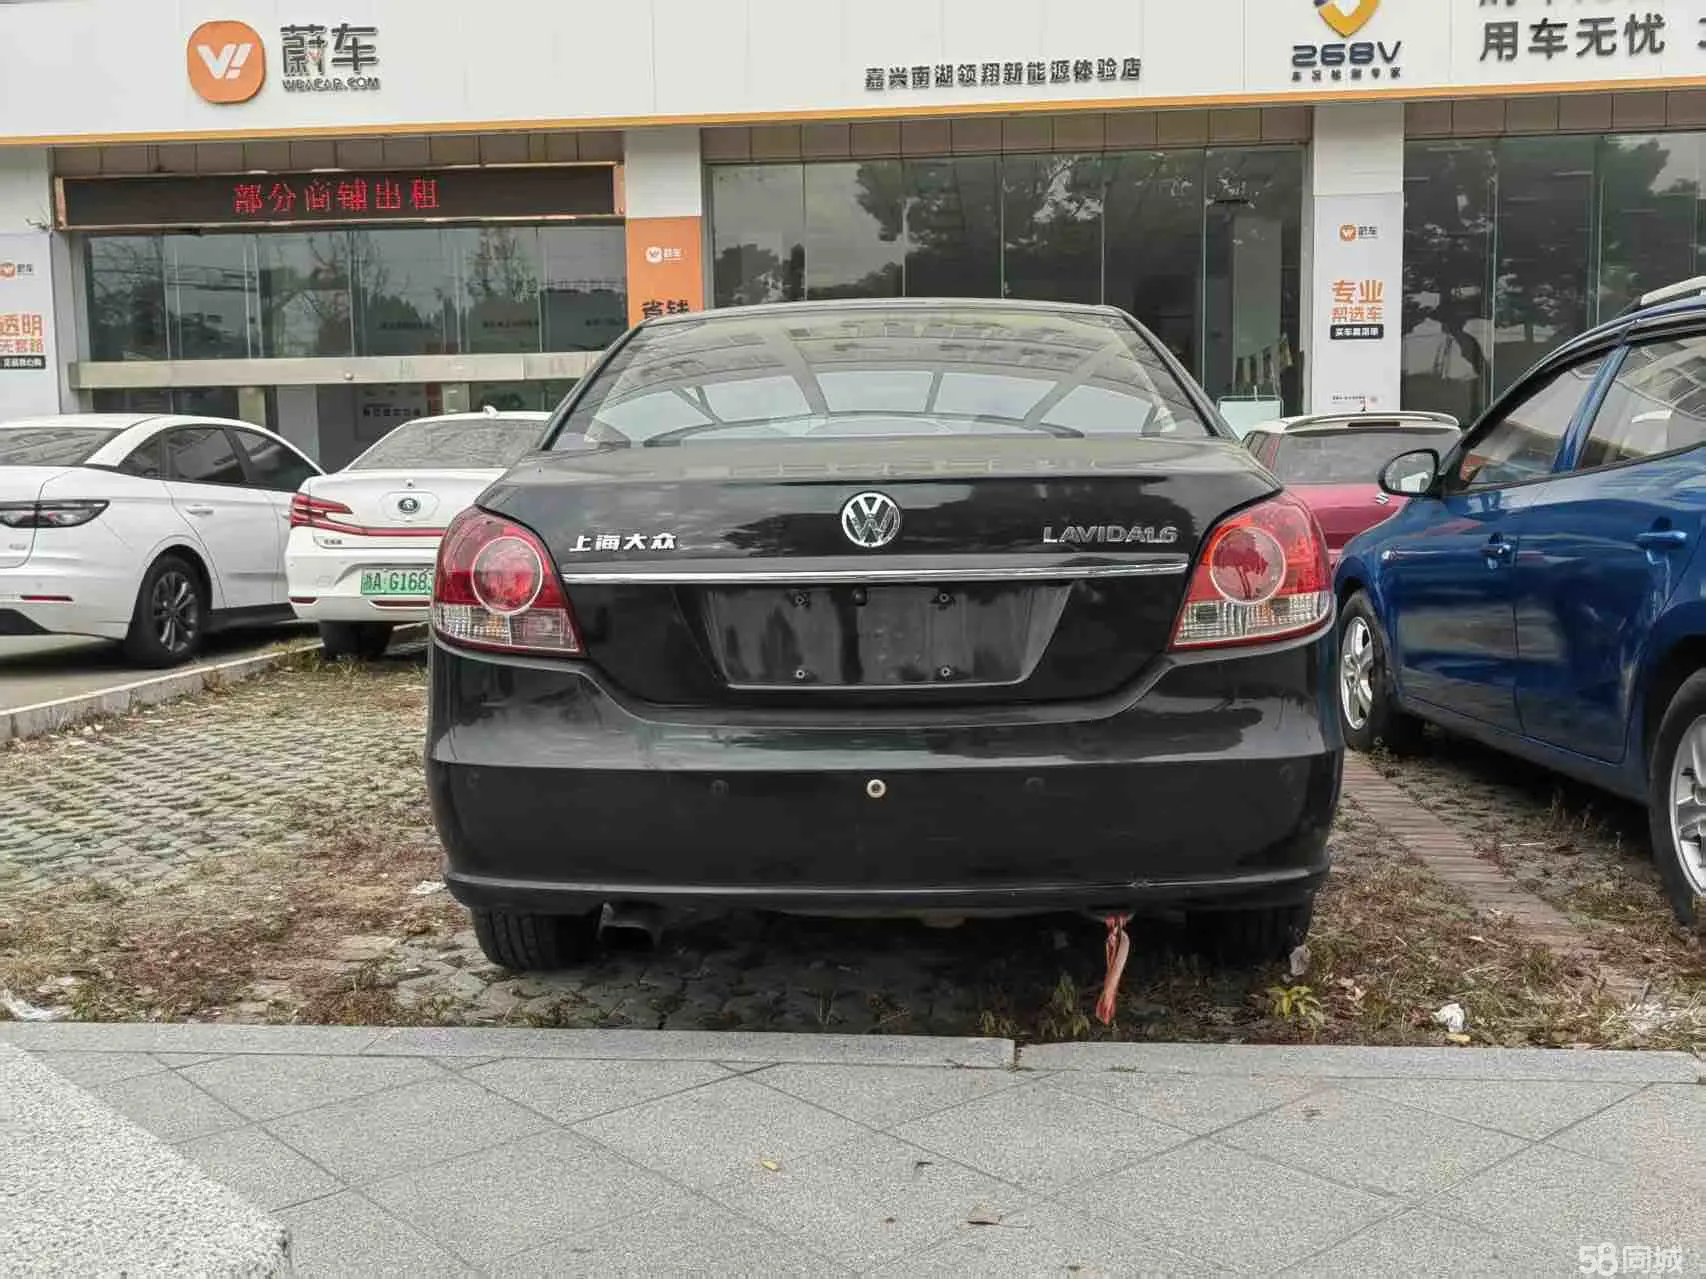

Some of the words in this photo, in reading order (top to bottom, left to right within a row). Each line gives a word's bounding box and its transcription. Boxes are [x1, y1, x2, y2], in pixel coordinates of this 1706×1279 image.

[280, 23, 377, 76] 蔚车
[1479, 12, 1665, 61] 用车无忧
[1292, 41, 1401, 67] 268V
[864, 57, 1142, 90] 嘉兴南湖领翔新能源体验店
[1332, 279, 1384, 304] 专业
[569, 533, 678, 552] 上海大众
